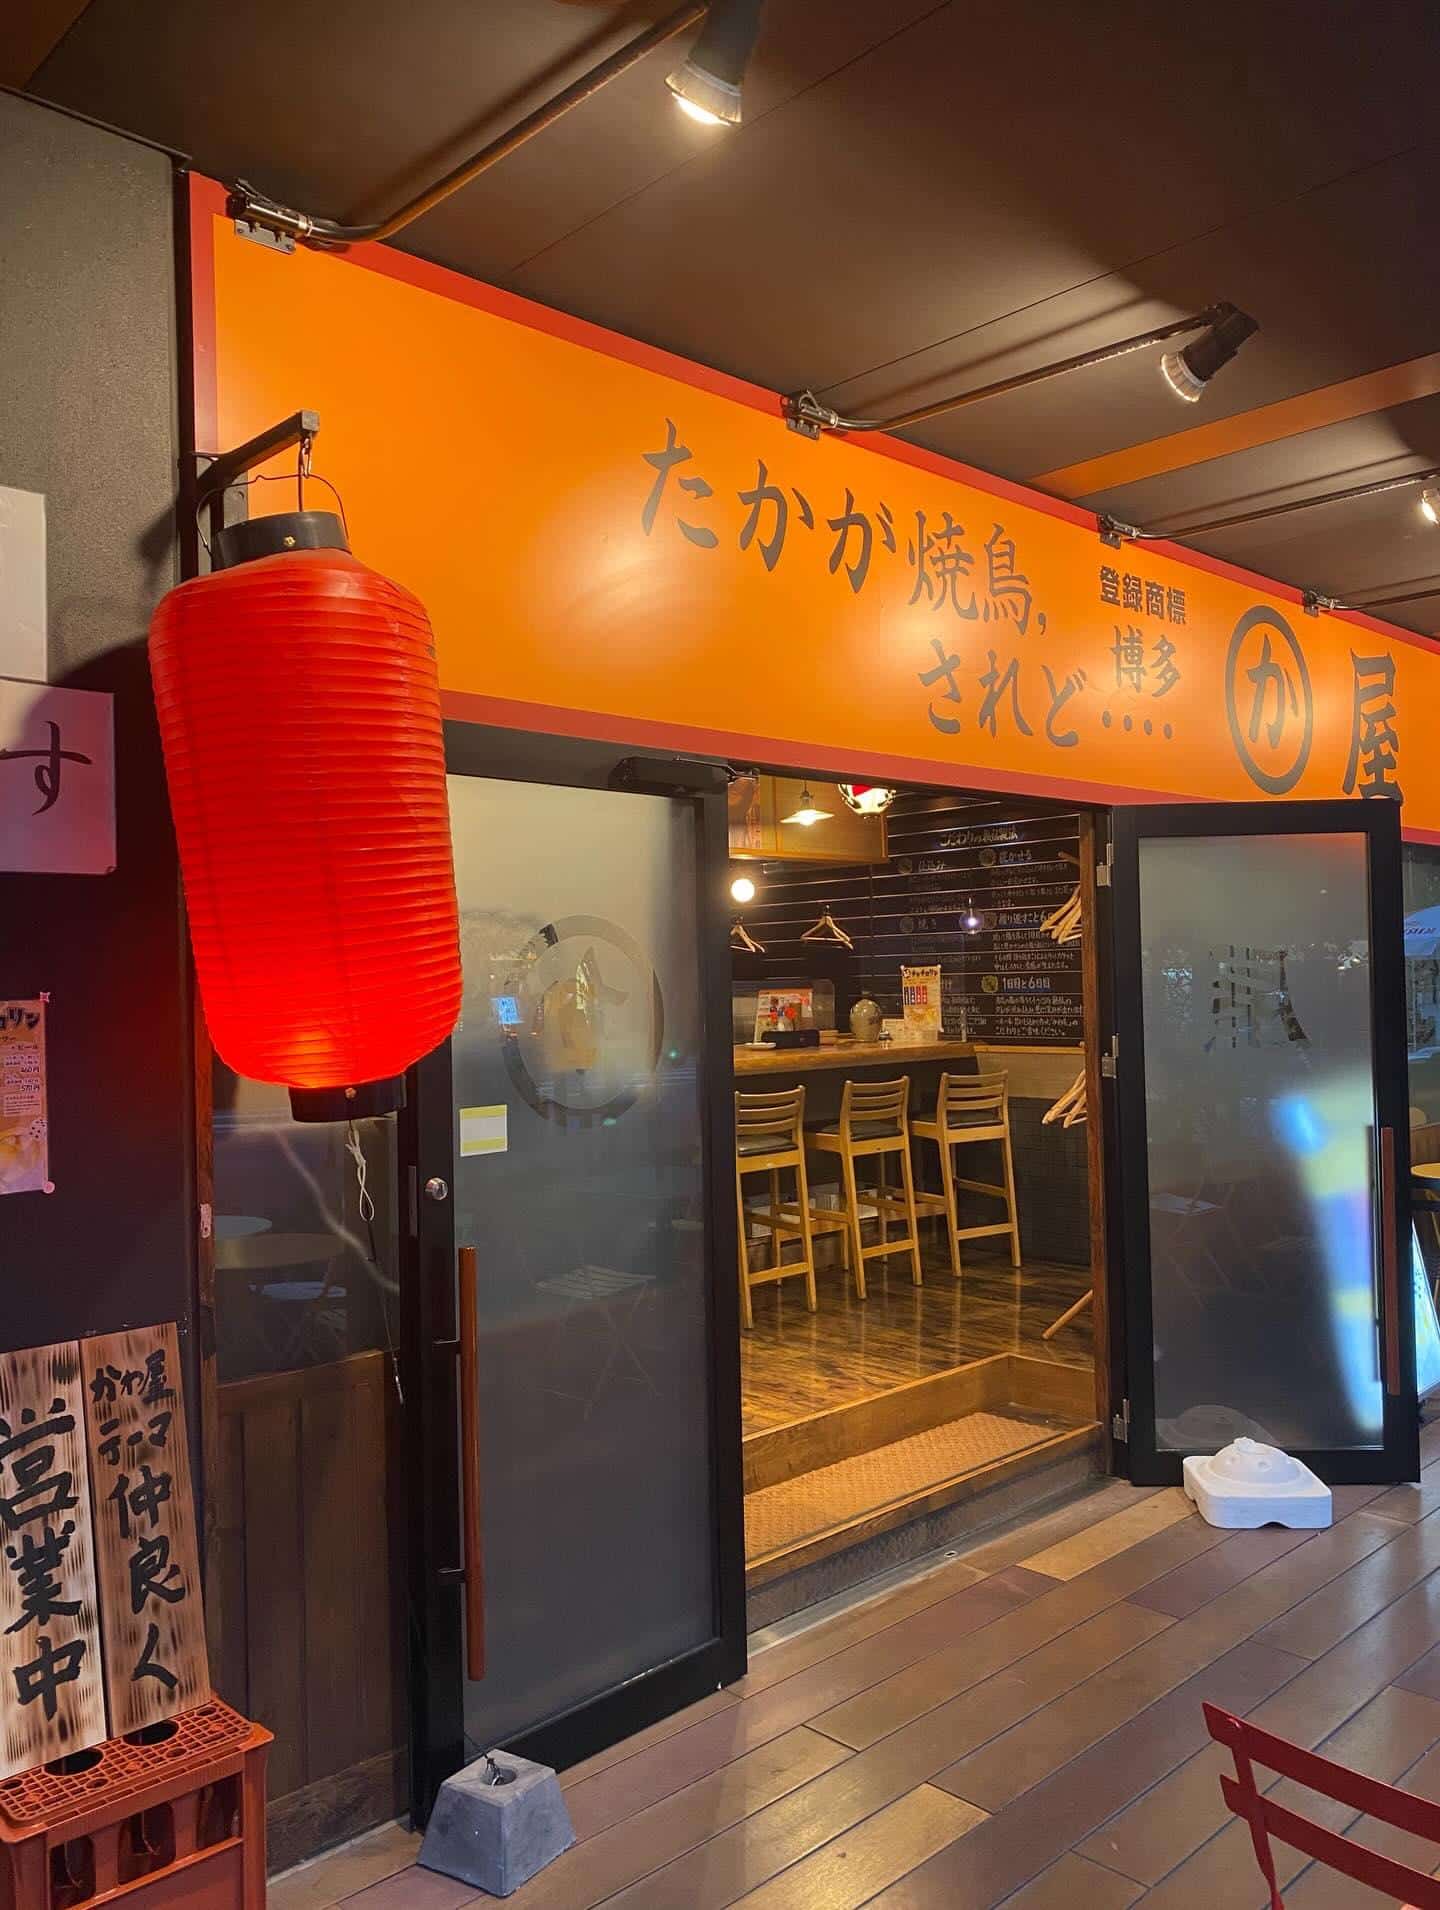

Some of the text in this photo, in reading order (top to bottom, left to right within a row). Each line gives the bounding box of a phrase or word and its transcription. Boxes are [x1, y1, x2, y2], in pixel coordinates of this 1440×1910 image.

[1099, 565, 1187, 626] 登録商標
[1110, 624, 1182, 698] 博多
[98, 1411, 172, 1466] テーマ
[0, 1397, 87, 1721] 営業中
